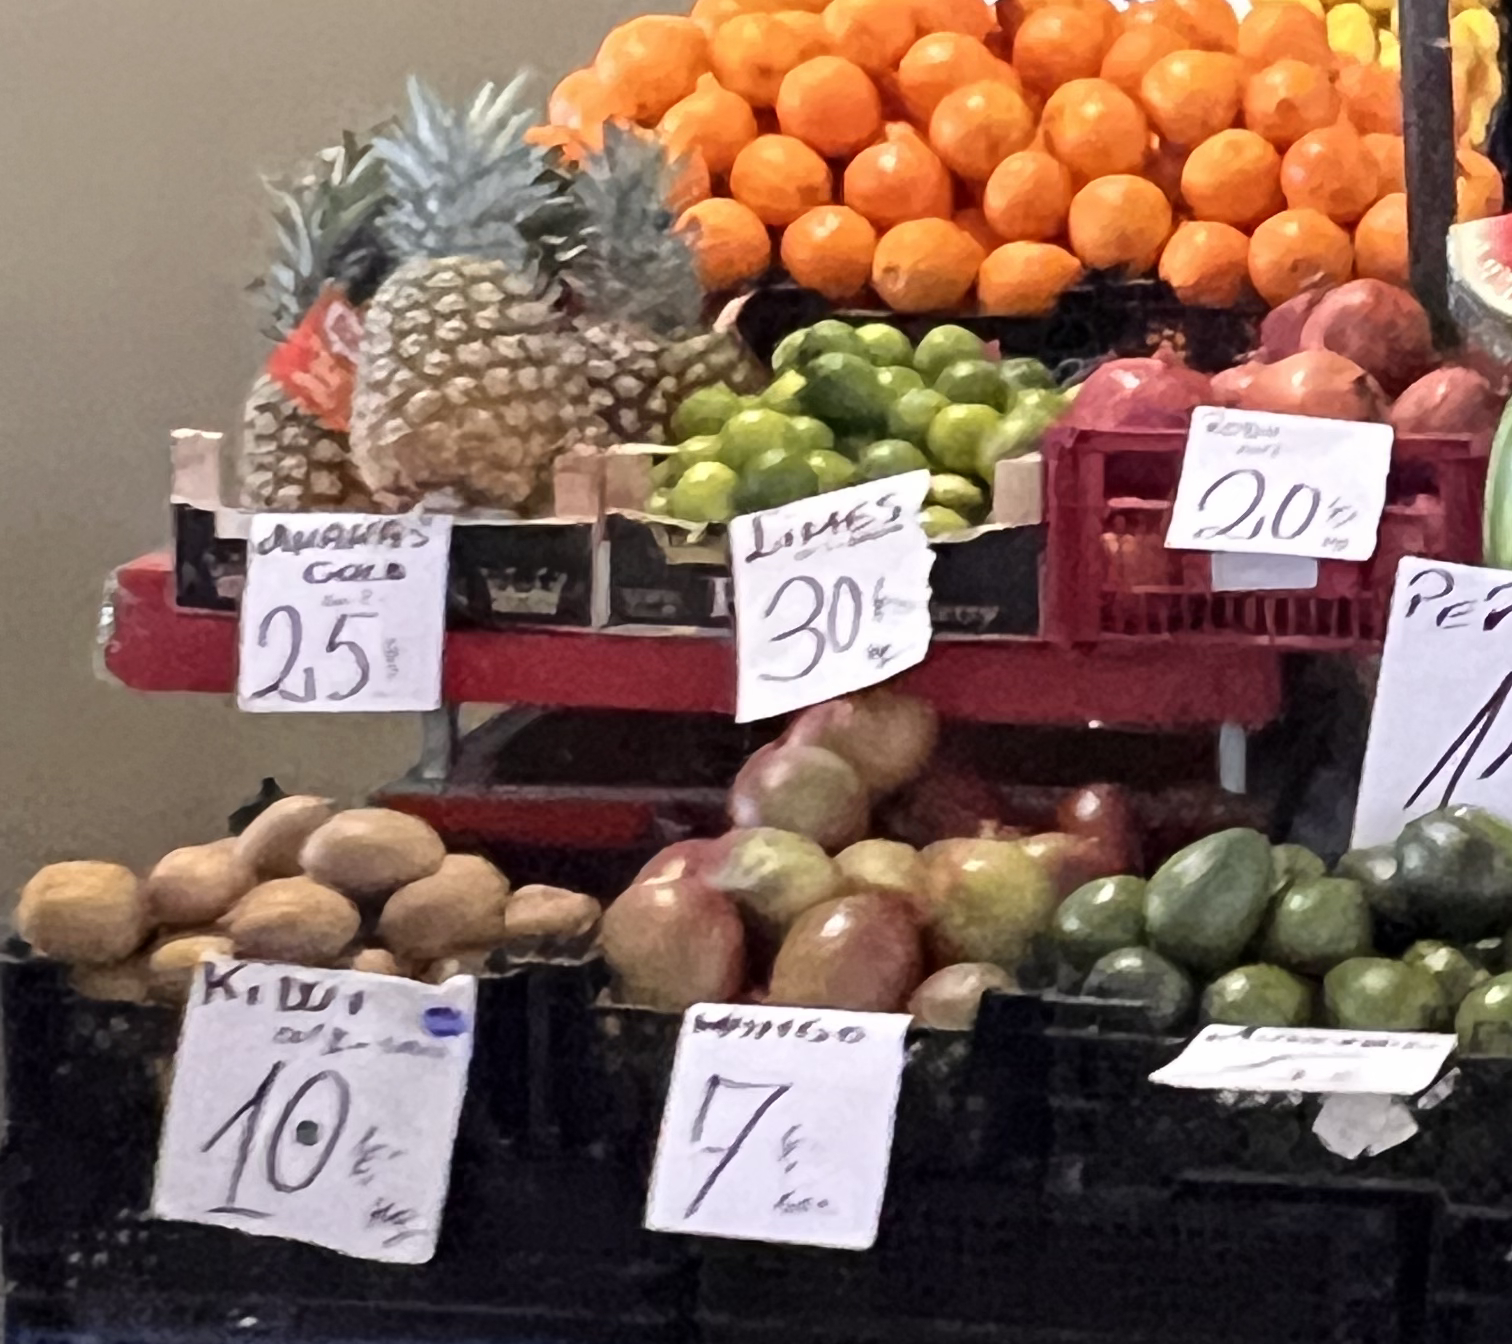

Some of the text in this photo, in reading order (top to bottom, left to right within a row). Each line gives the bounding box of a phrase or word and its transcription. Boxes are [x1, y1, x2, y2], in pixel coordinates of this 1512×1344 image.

[1193, 469, 1321, 540] 20
[250, 605, 378, 702] 25
[758, 575, 863, 682] 30
[202, 1060, 351, 1218] 10
[683, 1073, 793, 1219] 7
